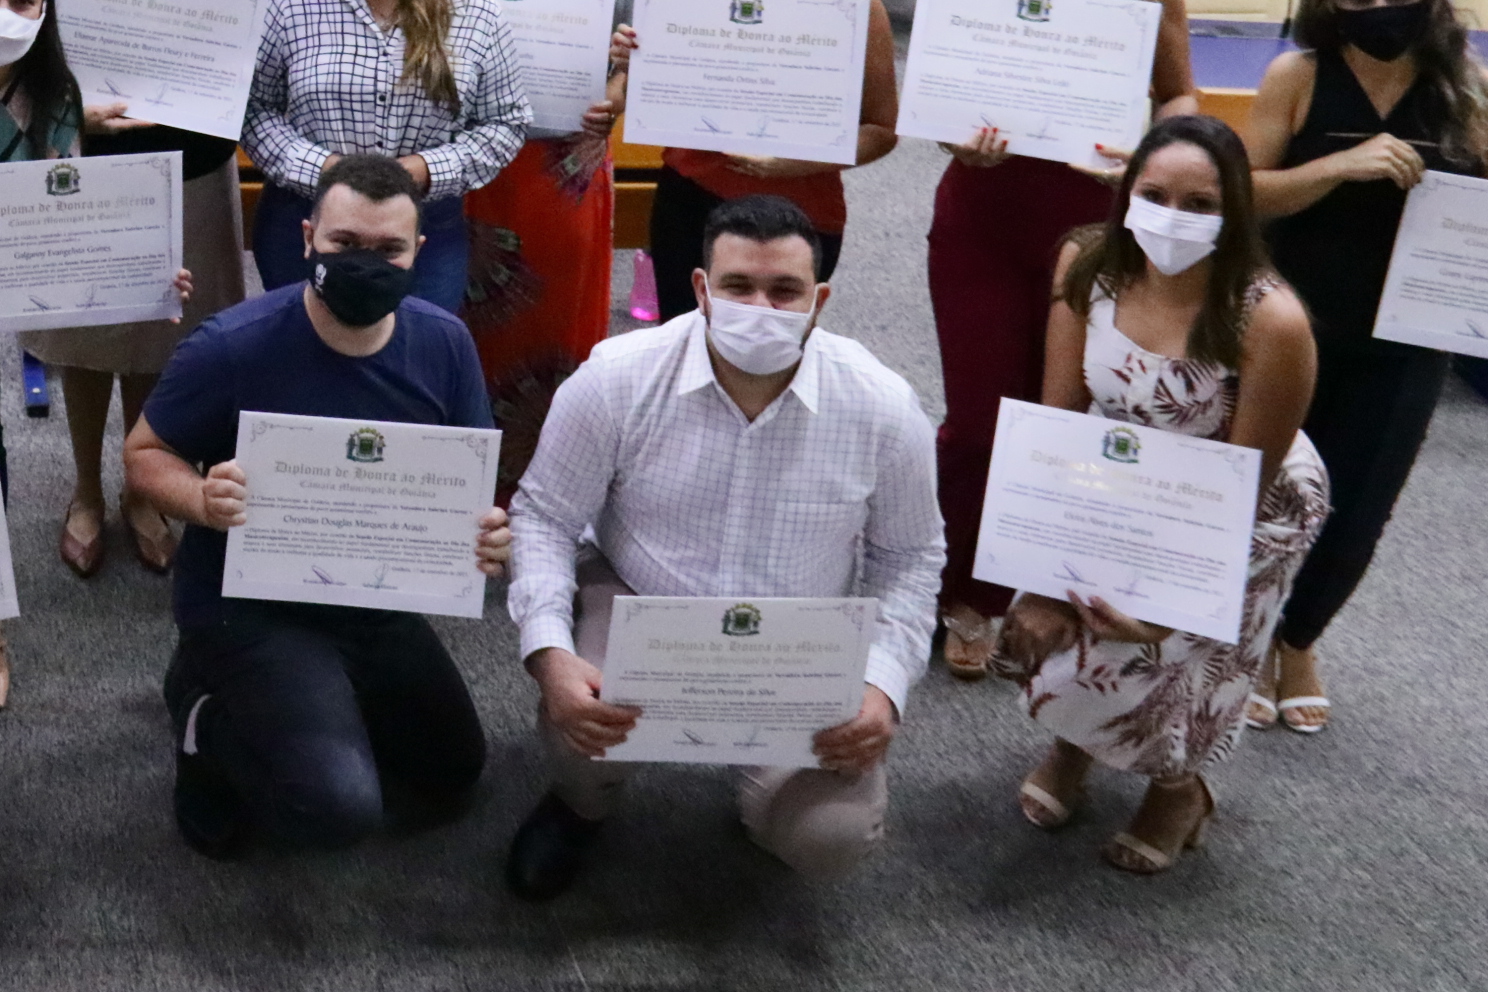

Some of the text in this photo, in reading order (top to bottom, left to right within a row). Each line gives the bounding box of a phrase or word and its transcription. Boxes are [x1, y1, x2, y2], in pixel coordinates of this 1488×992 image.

[666, 22, 715, 36] Diploma
[719, 28, 731, 37] de
[778, 35, 791, 43] ao
[1005, 24, 1017, 34] de
[38, 203, 50, 212] de
[56, 200, 93, 211] Honra
[96, 200, 110, 208] ao
[274, 461, 330, 476] Diploma
[335, 466, 348, 477] de
[354, 466, 396, 481] Honra
[400, 473, 415, 483] ao
[321, 517, 352, 528] Douglas
[354, 519, 387, 528] Marques
[389, 521, 398, 529] de
